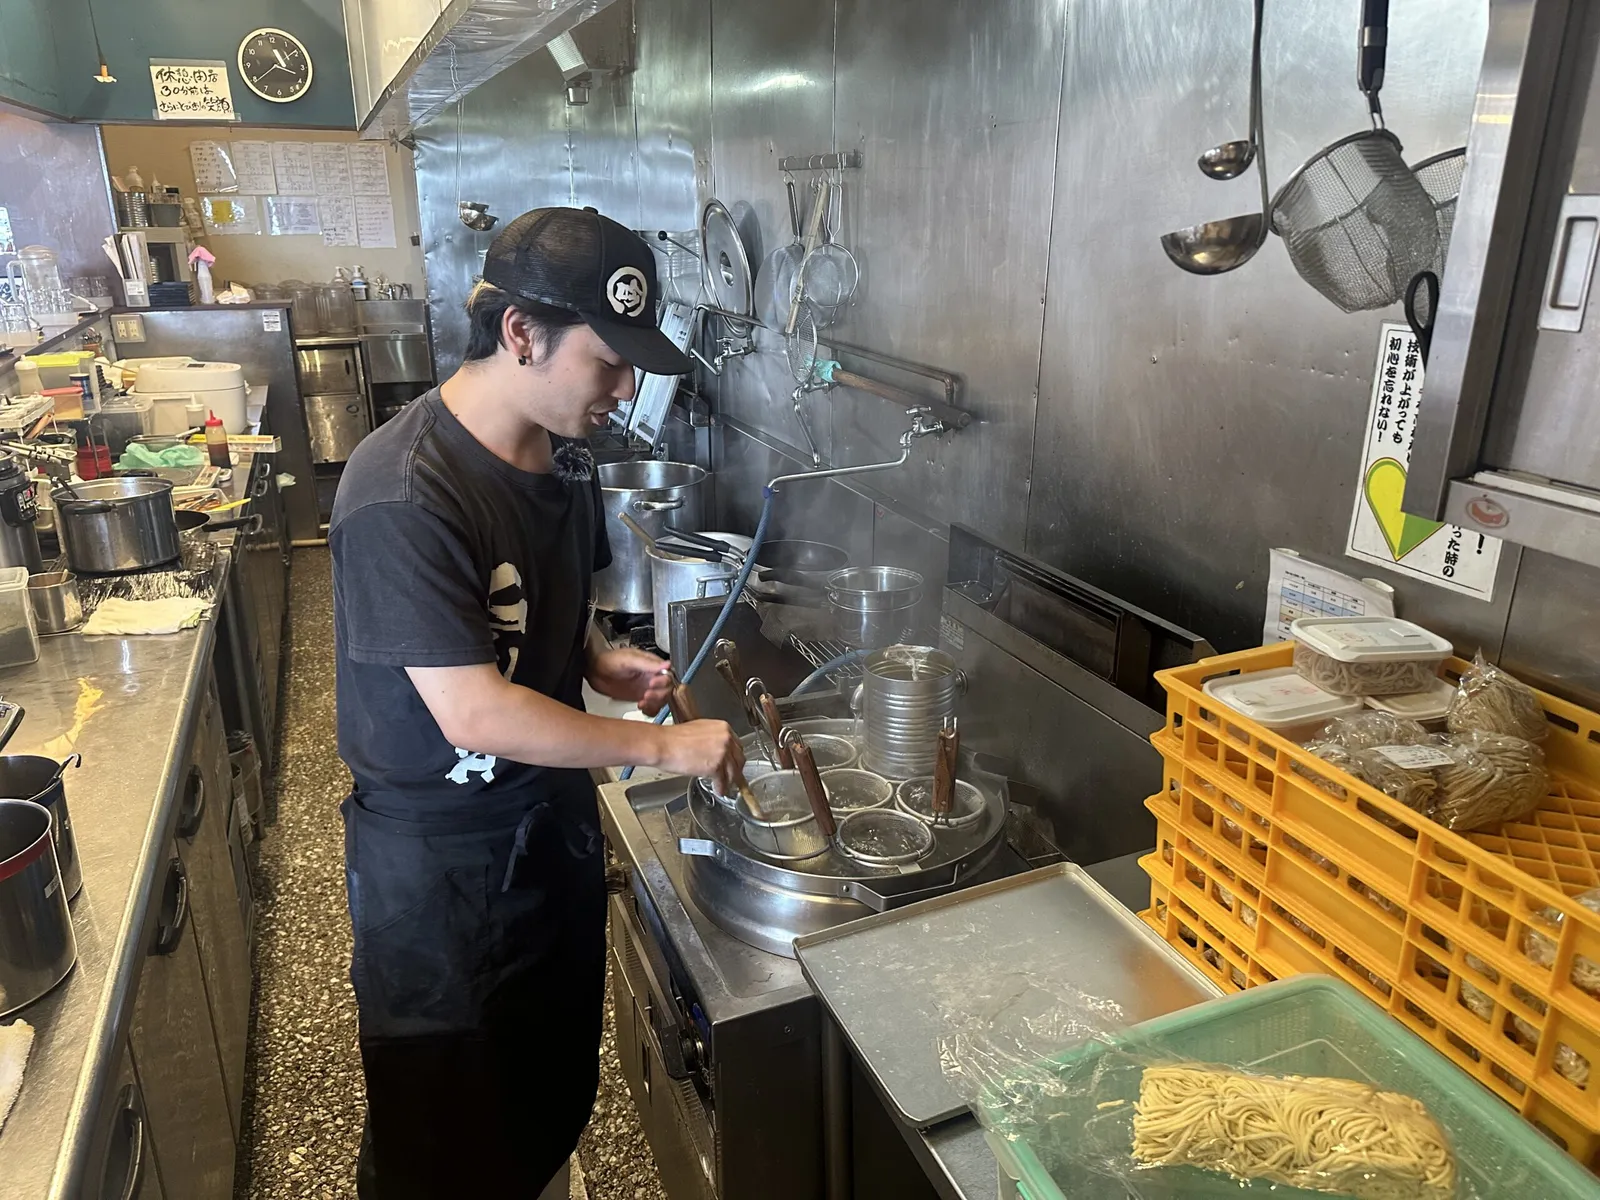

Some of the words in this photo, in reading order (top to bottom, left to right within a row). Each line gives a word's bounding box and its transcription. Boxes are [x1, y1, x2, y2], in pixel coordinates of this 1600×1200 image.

[1376, 336, 1402, 443] 初心を忘れない！
[1392, 338, 1420, 444] 技術が上がっても
[1442, 525, 1462, 578] った時の
